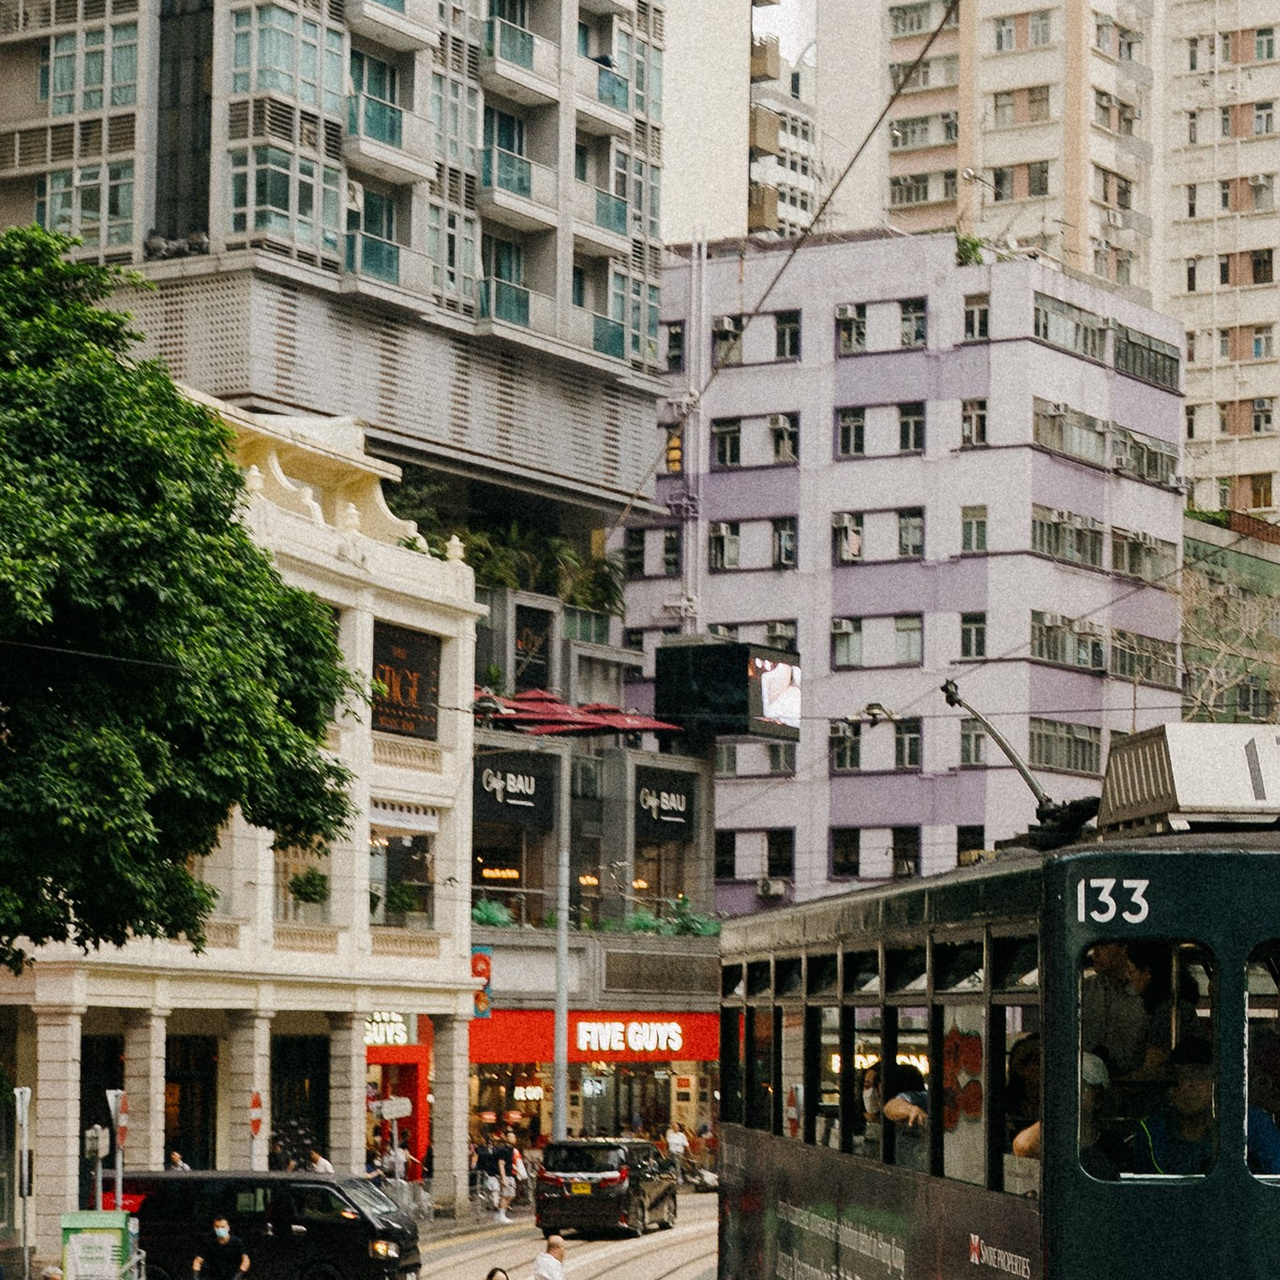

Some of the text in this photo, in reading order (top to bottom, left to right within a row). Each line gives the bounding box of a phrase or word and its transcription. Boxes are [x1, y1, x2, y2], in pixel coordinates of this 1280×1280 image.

[506, 773, 536, 796] BAU
[660, 792, 687, 812] BAU
[1077, 878, 1150, 924] 133
[577, 1022, 683, 1053] FIVE GUYS
